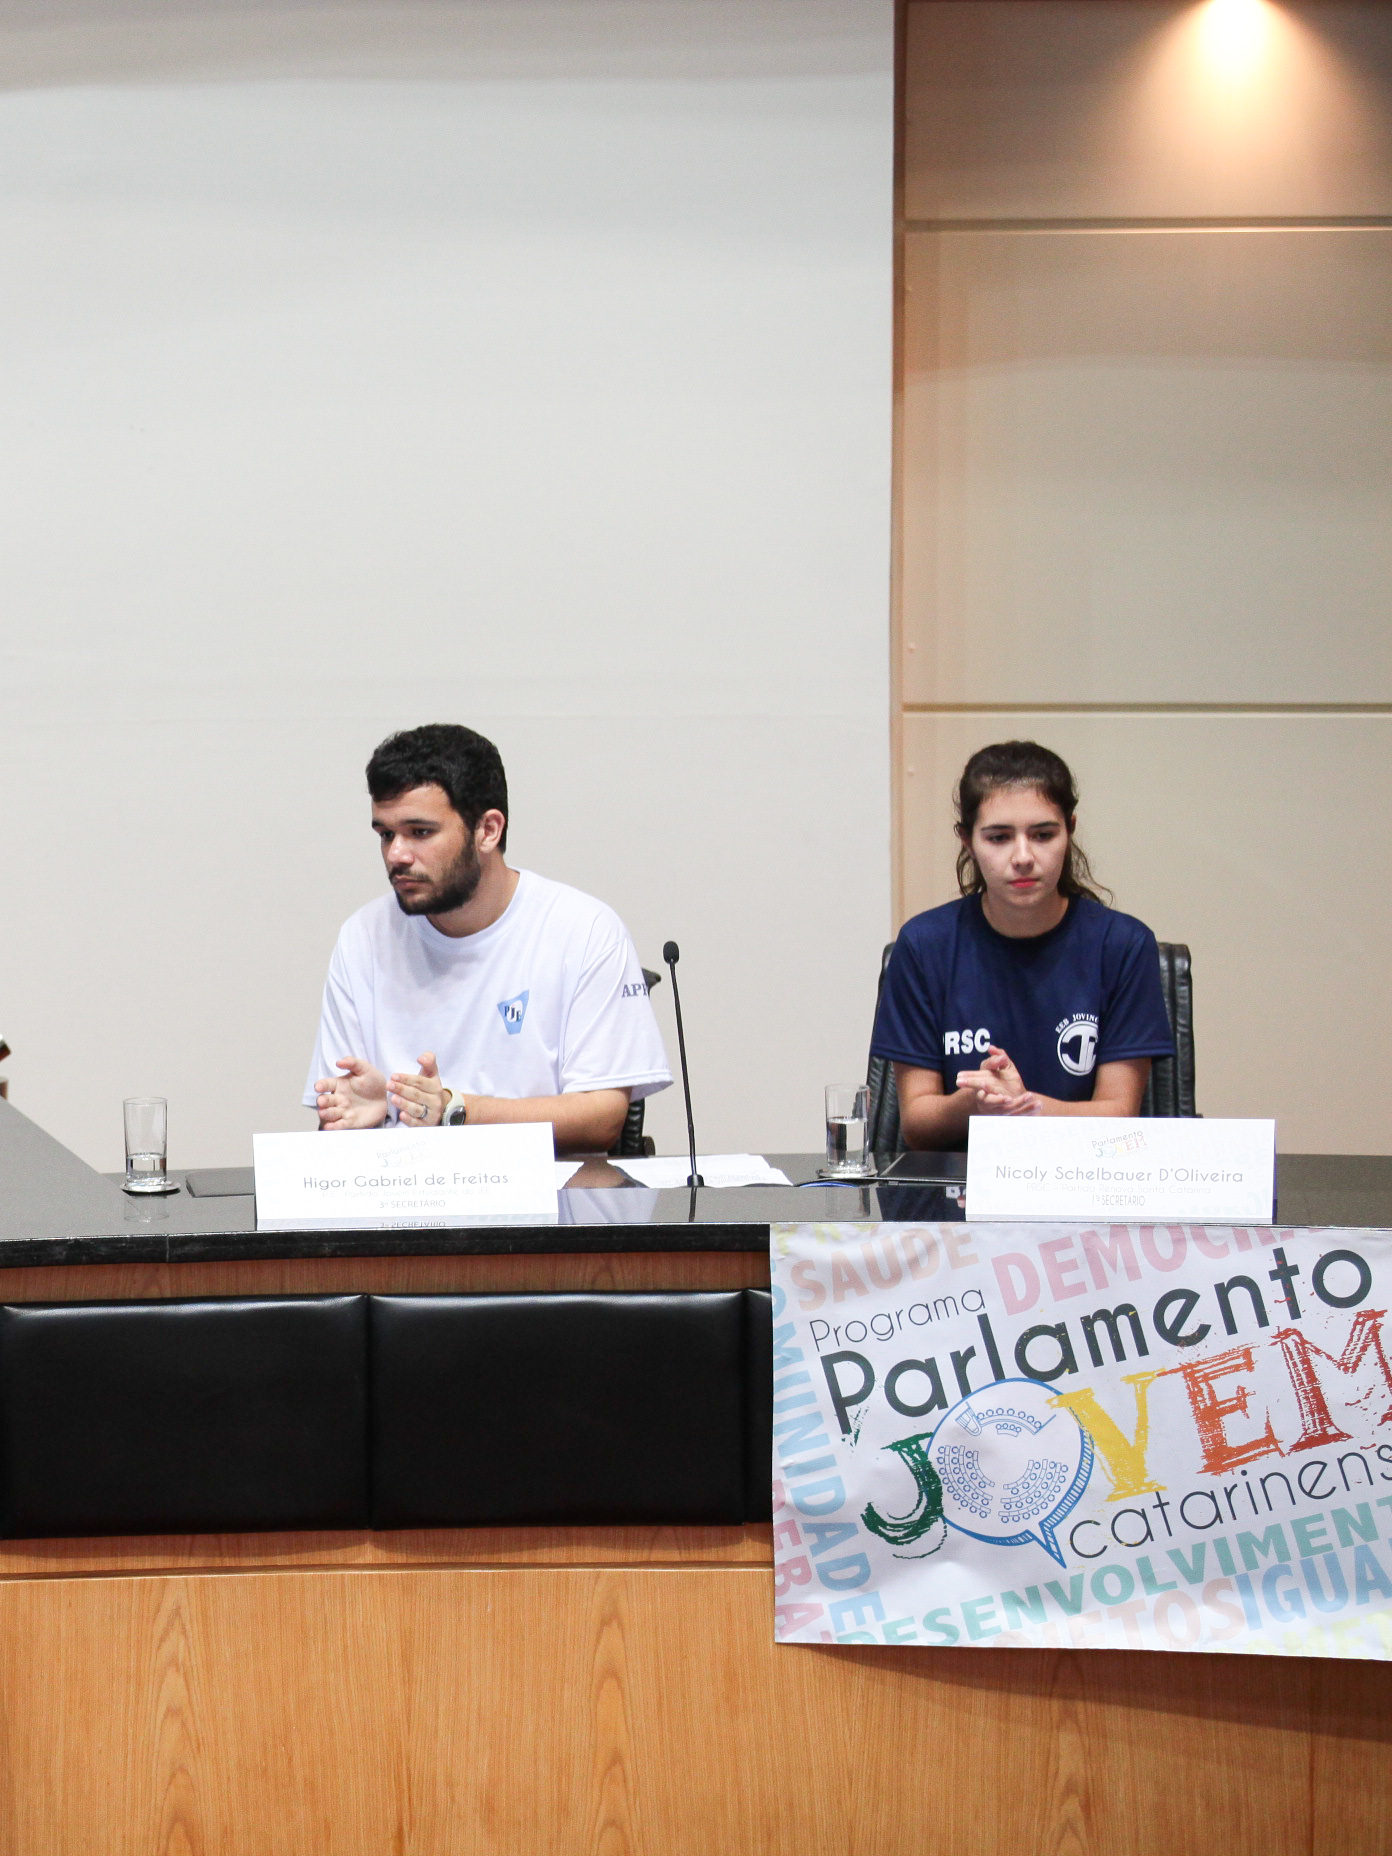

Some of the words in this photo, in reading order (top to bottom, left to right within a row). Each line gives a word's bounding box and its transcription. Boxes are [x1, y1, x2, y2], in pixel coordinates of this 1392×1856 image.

[943, 1028, 990, 1055] RSC
[303, 1176, 347, 1191] Higor
[354, 1174, 419, 1189] Gabriel
[425, 1173, 446, 1186] de
[453, 1172, 509, 1186] Freitas
[995, 1166, 1047, 1181] Nicoly
[1055, 1167, 1152, 1181] Schelbauer
[1159, 1168, 1243, 1182] D'Oliveira
[809, 1289, 986, 1352] Programa
[819, 1247, 1372, 1434] Parlamento
